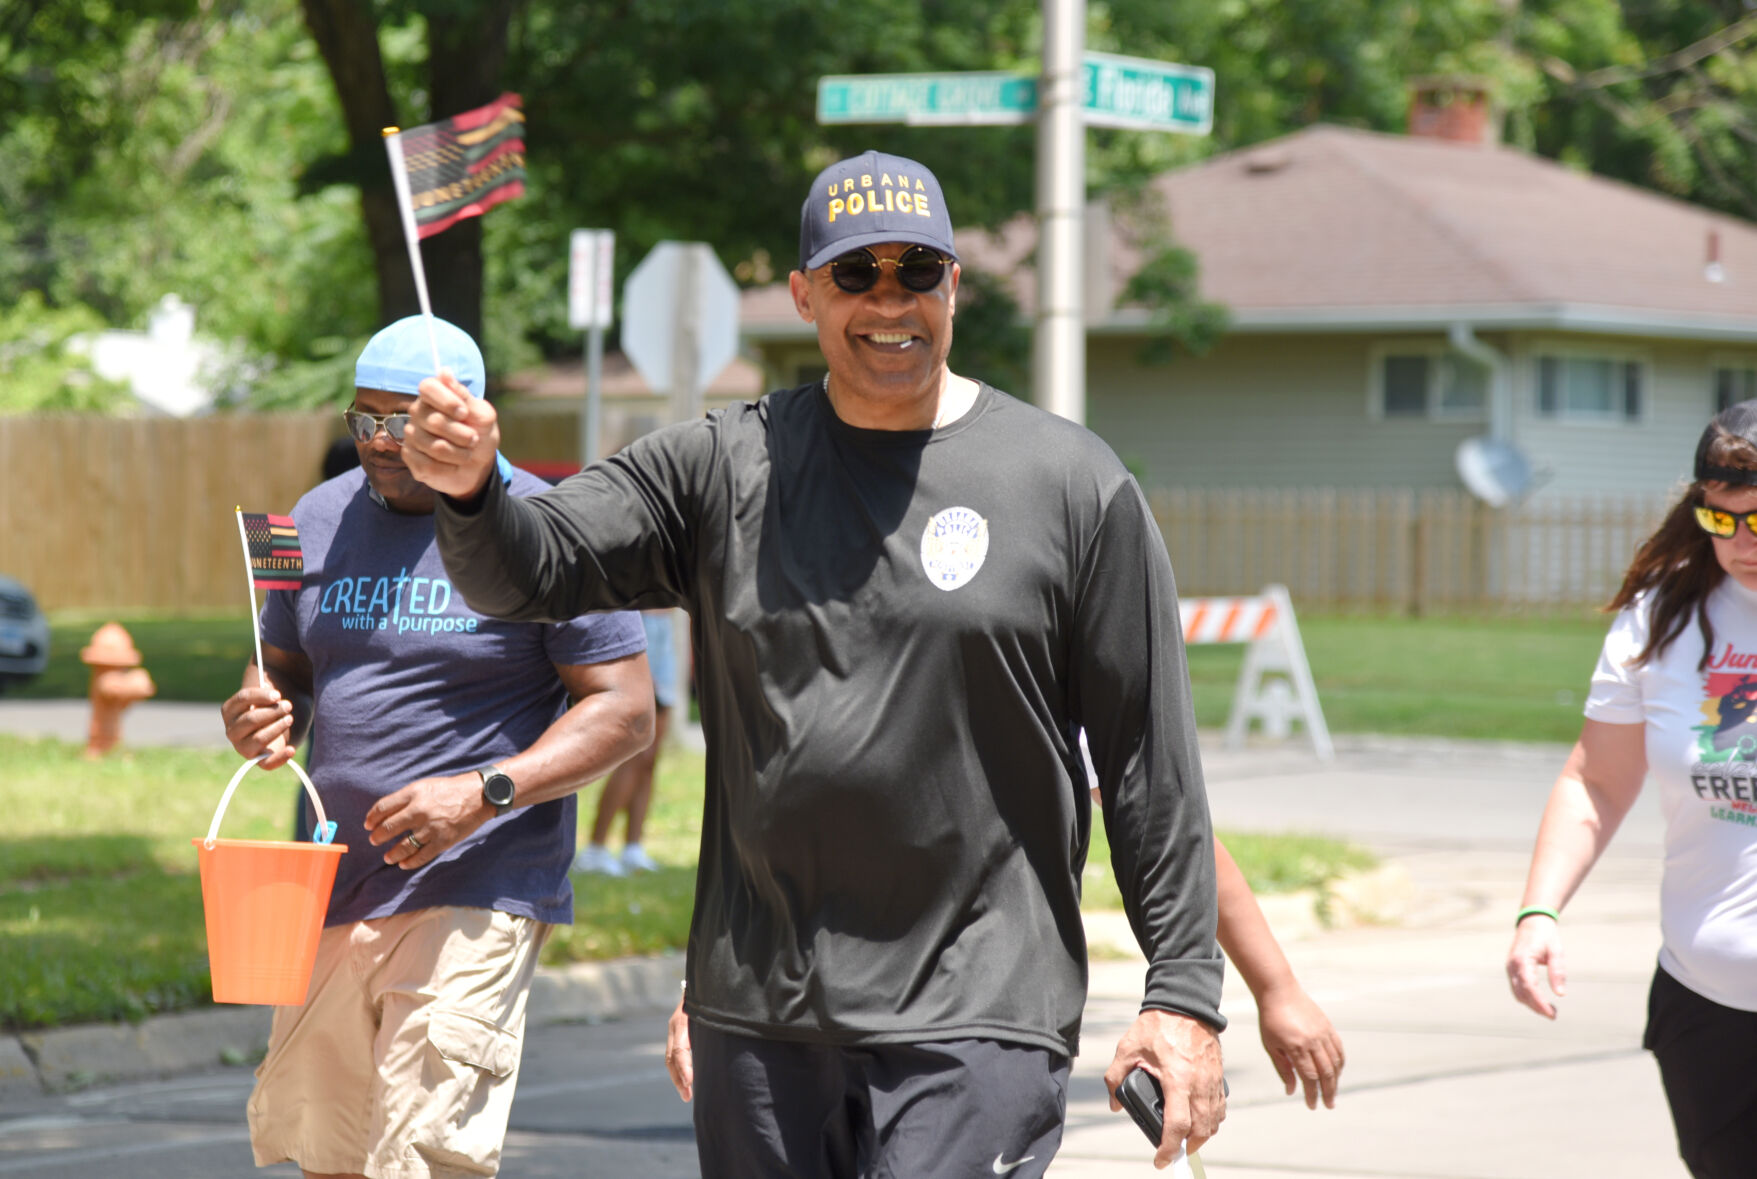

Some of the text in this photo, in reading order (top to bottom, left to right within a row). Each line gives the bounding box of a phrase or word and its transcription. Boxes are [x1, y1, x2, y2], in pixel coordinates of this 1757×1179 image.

[1098, 65, 1174, 116] Florida
[828, 173, 925, 197] URBANA
[828, 189, 931, 223] POLICE
[320, 566, 451, 625] CREATED
[341, 613, 478, 636] with a purpose
